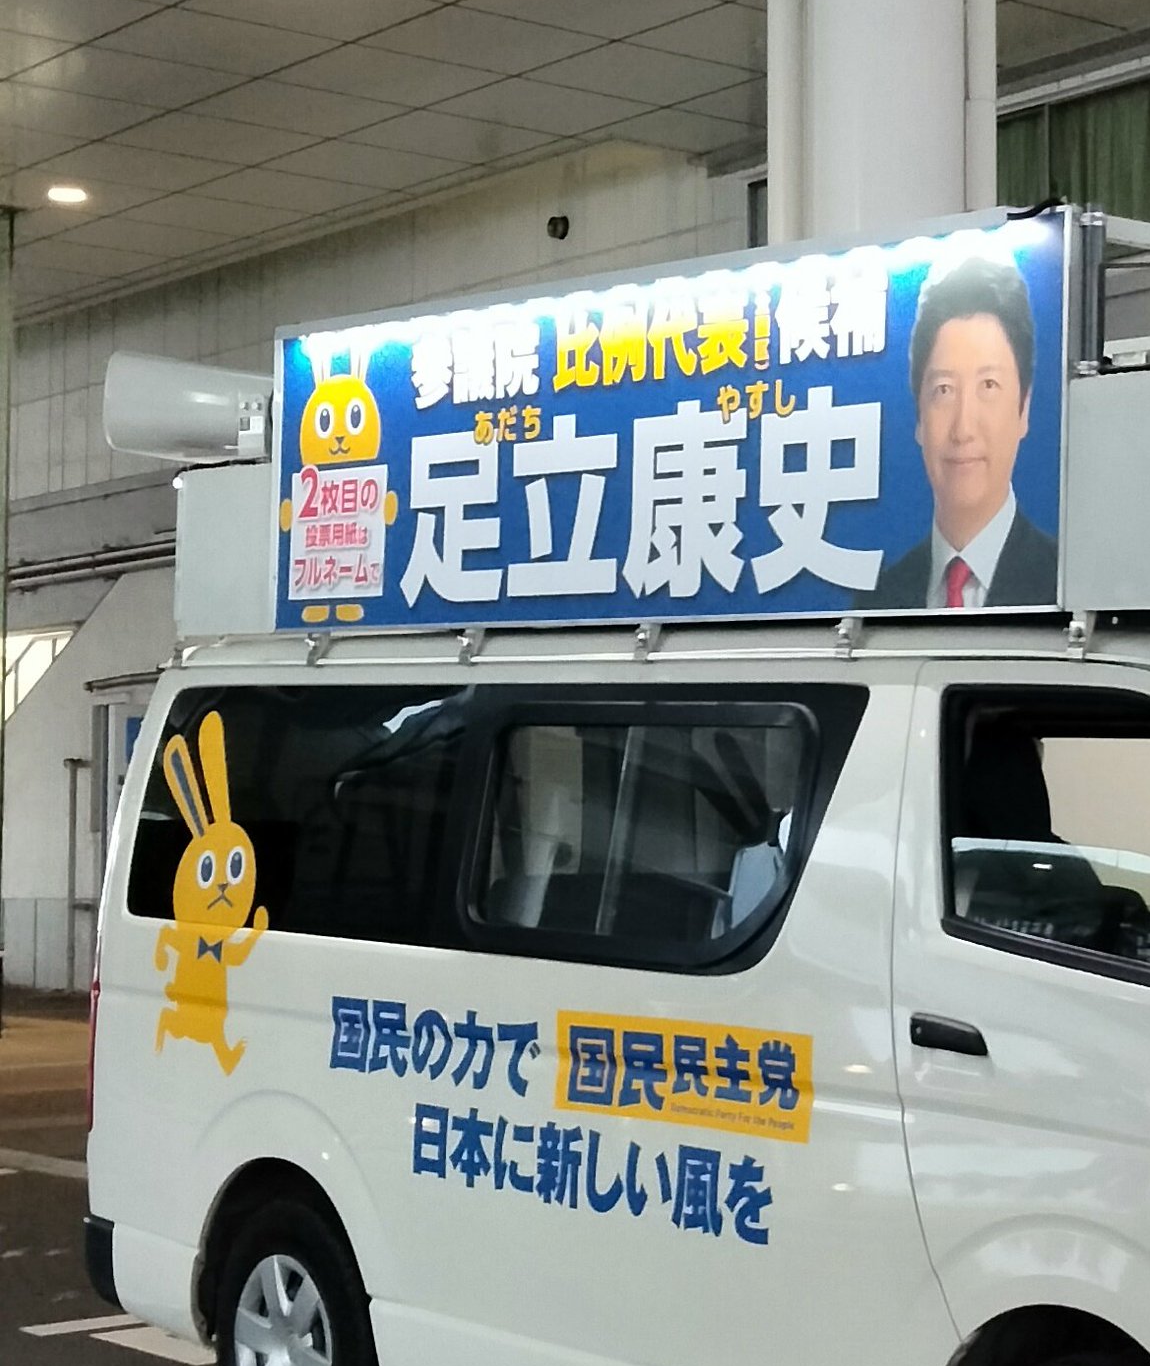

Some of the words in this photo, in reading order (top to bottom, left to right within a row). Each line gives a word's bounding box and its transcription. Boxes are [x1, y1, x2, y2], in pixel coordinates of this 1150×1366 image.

[553, 283, 749, 393] 比例代表
[473, 403, 542, 446] あだち
[717, 379, 796, 424] やすし
[298, 466, 379, 521] 2枚目の
[400, 385, 884, 608] 足立康史
[330, 995, 541, 1097] 国民の力で
[568, 1024, 801, 1111] 国民民主党
[412, 1102, 773, 1246] 日本に新しい風を
